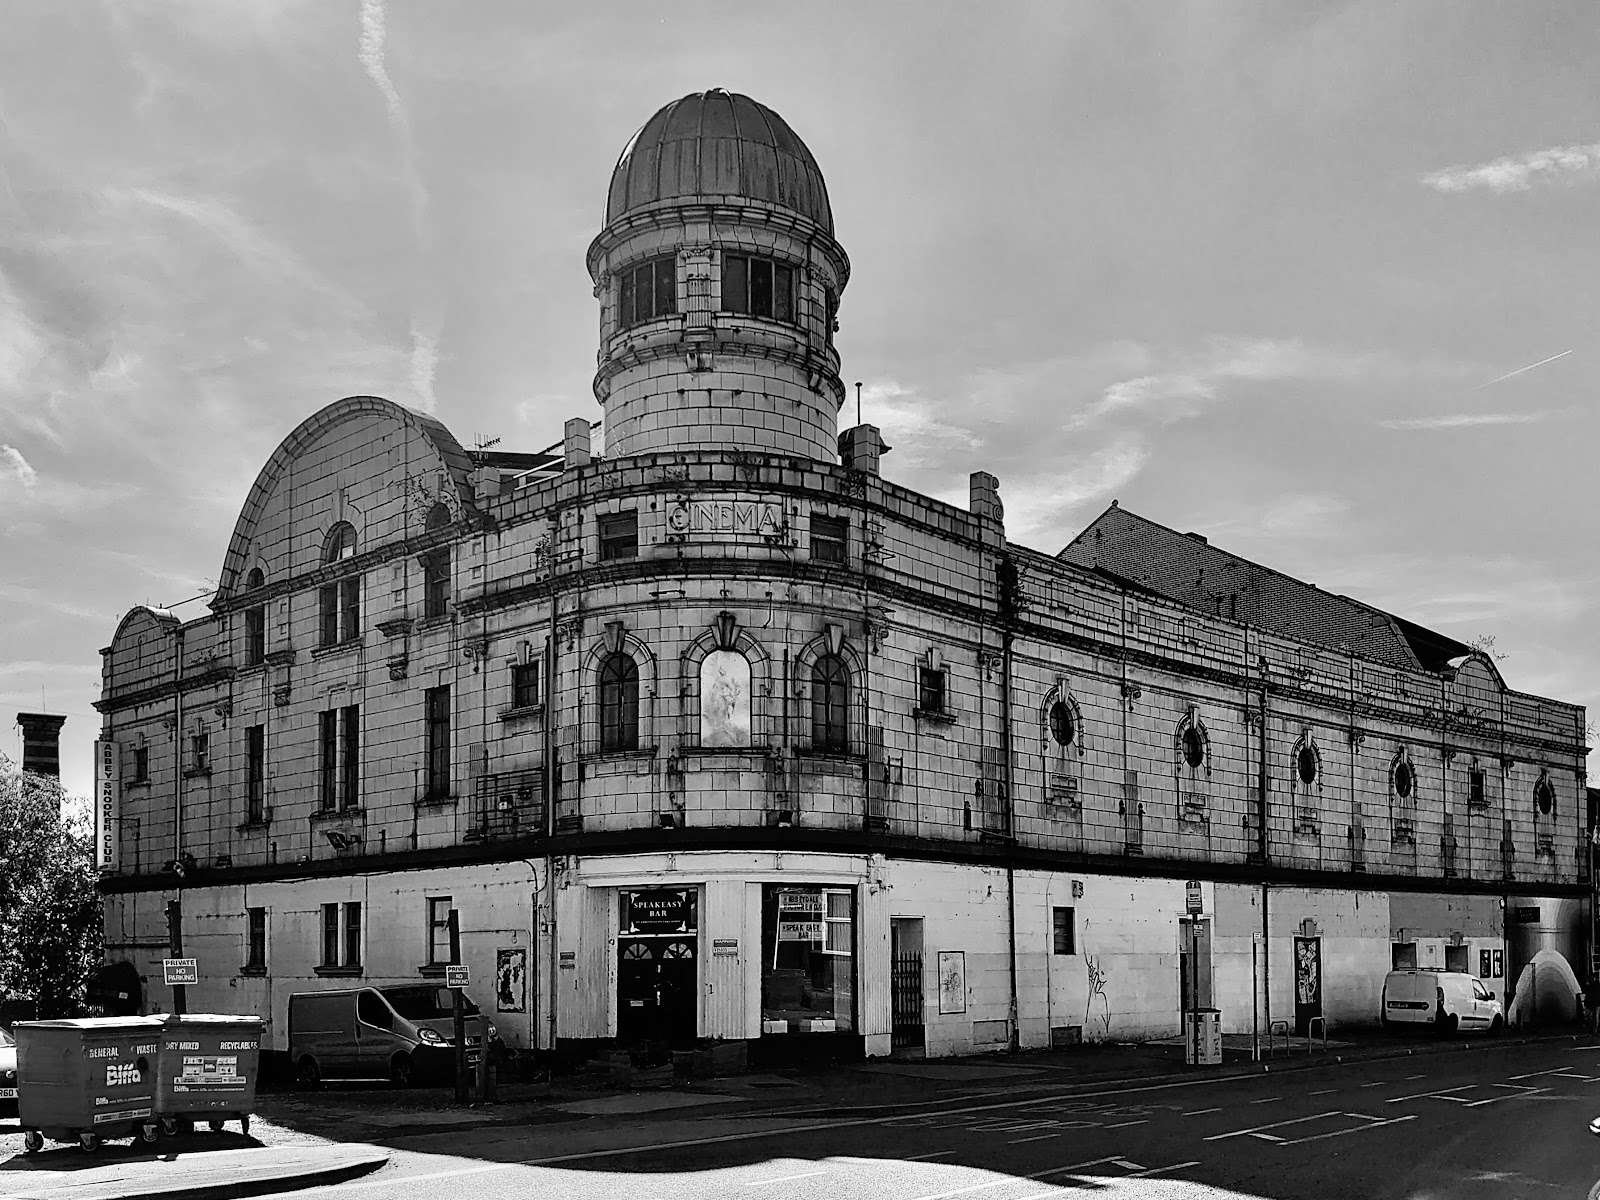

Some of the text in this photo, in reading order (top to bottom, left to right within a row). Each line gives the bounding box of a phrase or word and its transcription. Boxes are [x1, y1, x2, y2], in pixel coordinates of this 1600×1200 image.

[668, 501, 781, 532] CINEMA
[103, 743, 113, 863] ABBEY SNOOKER CLUB
[633, 900, 683, 909] SPEAKEASY
[89, 1044, 157, 1058] GENERAL WASTE
[179, 1041, 200, 1050] MIXED
[220, 1041, 258, 1050] RECYCLABLES
[106, 1063, 141, 1086] Biffa
[173, 1085, 189, 1093] Biffa
